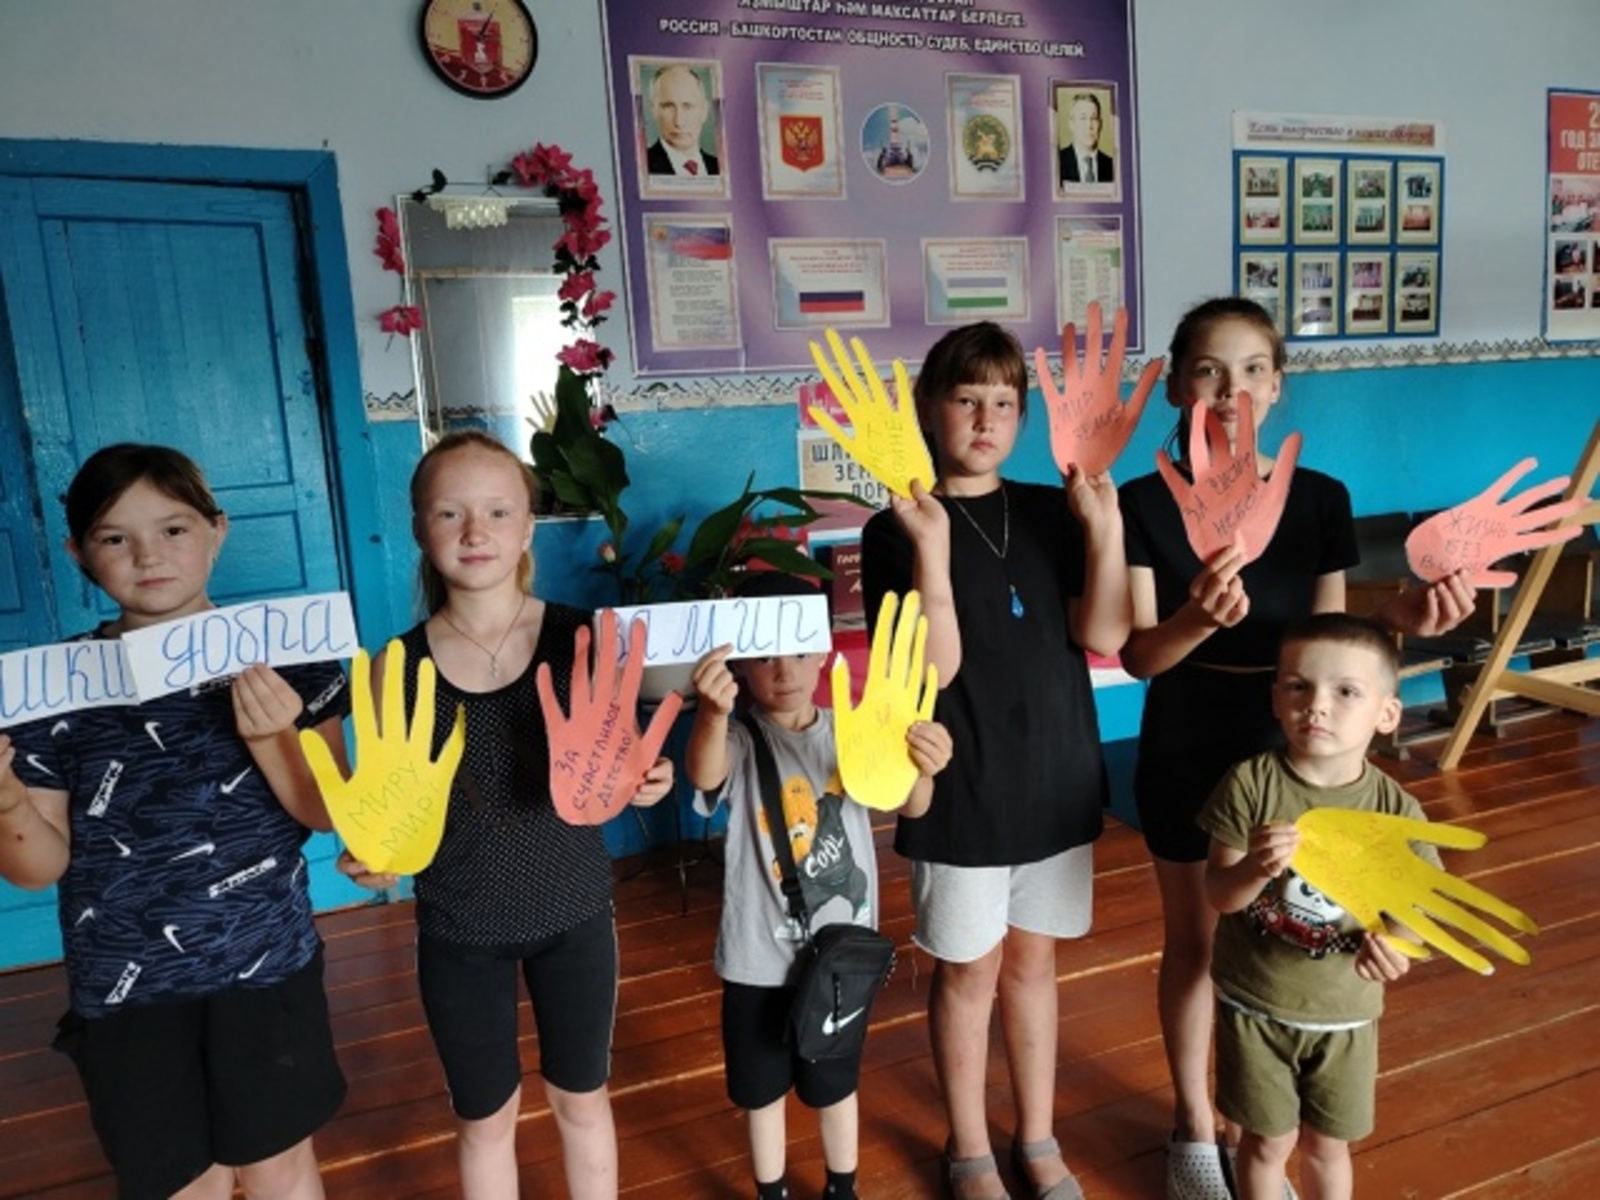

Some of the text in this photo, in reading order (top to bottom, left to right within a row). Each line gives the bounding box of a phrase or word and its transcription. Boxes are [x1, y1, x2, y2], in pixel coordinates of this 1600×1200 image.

[659, 19, 719, 34] РОССИЯ
[847, 29, 923, 47] ОБЩНОСТЬ
[974, 38, 1041, 55] ЕДИНСТВО
